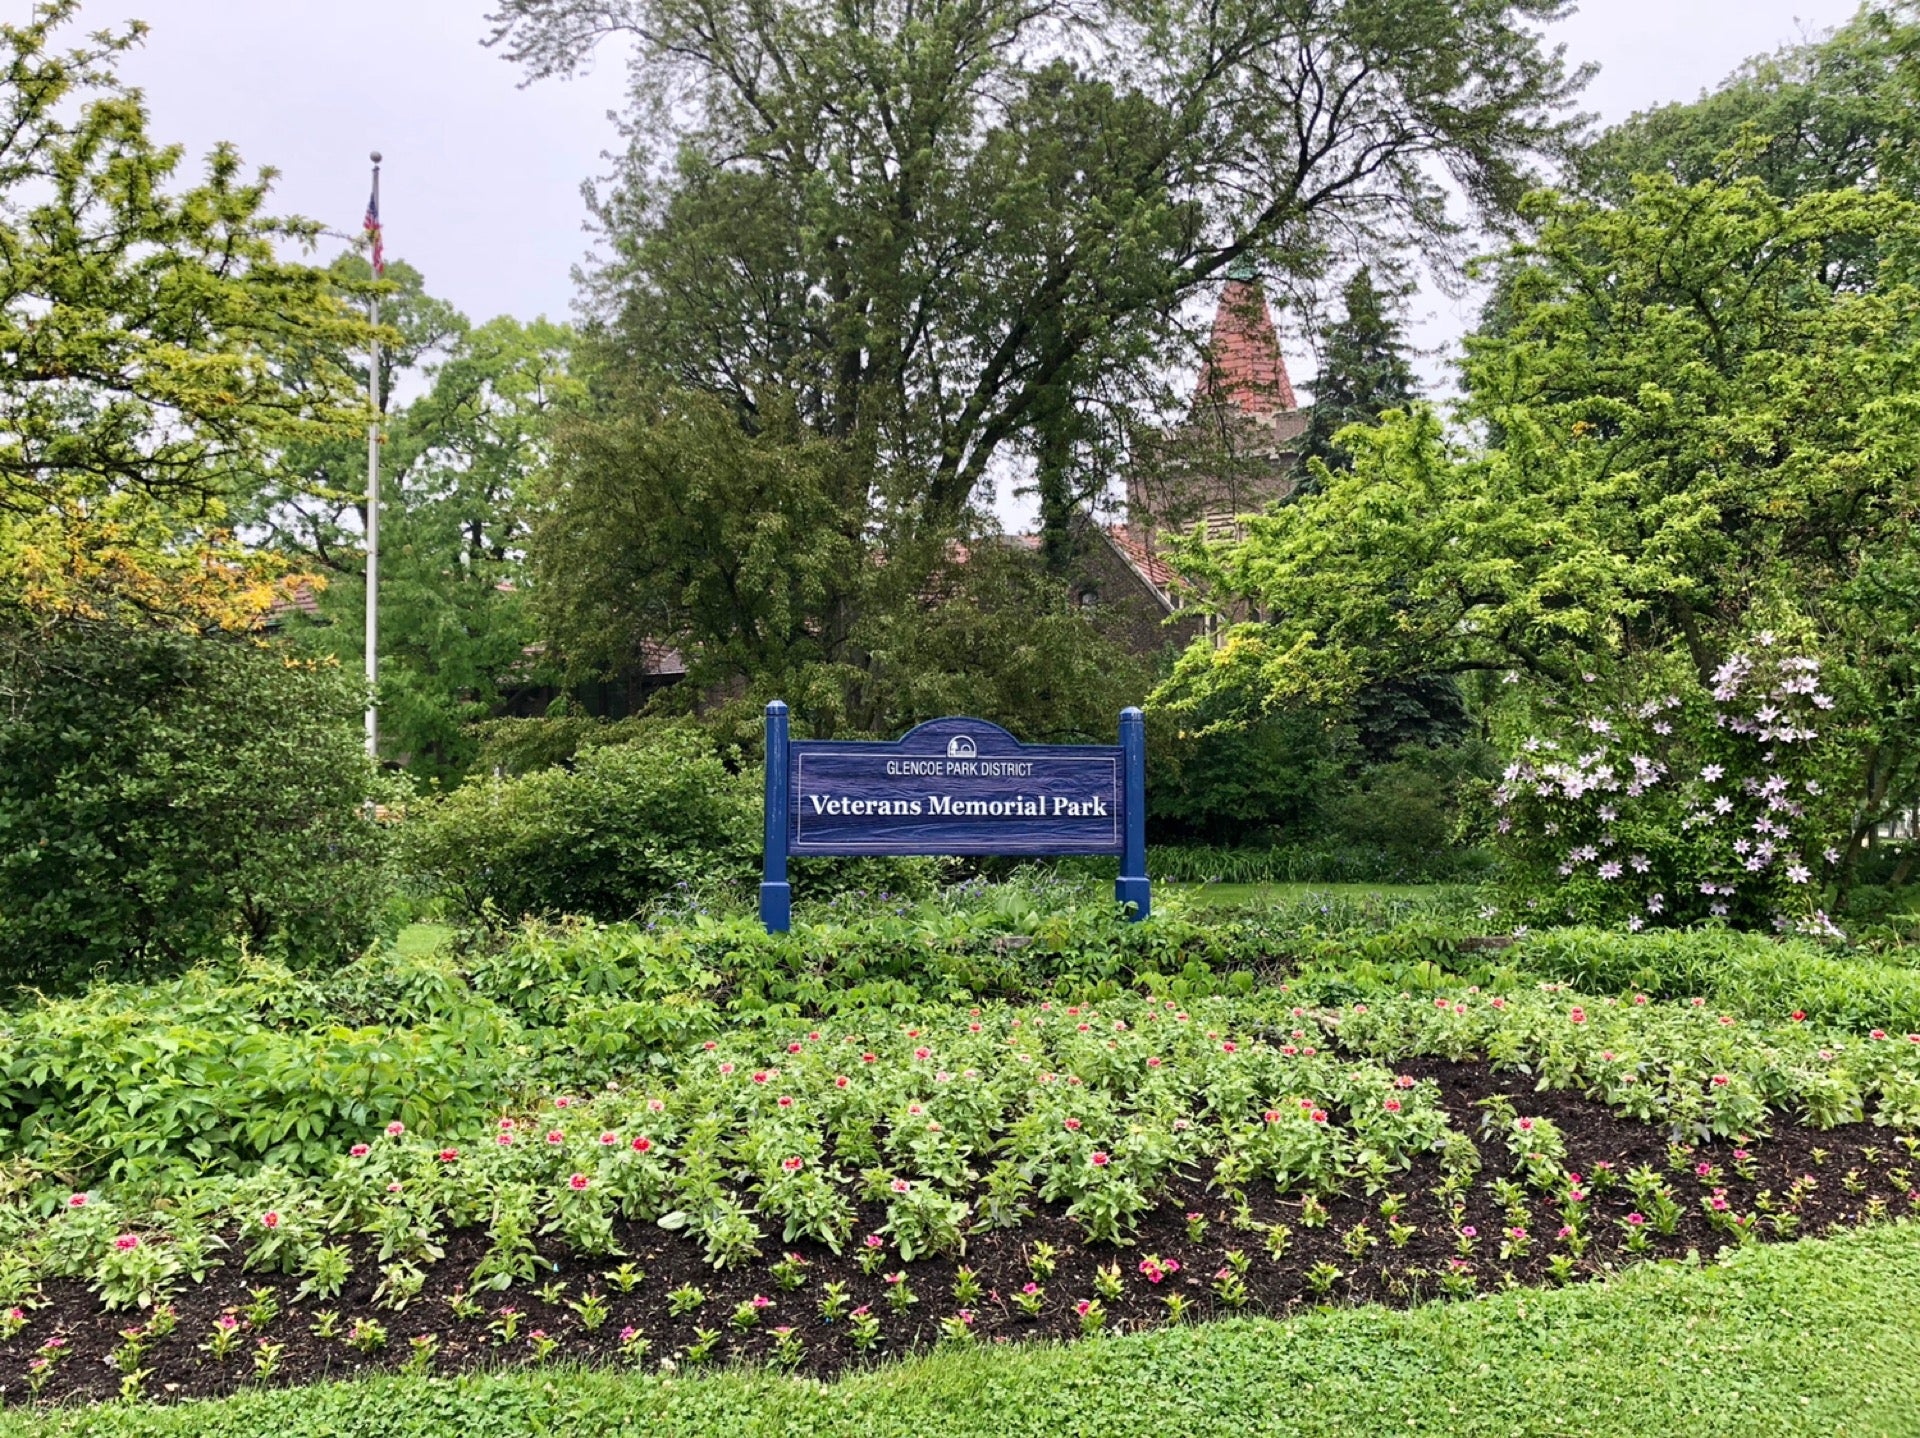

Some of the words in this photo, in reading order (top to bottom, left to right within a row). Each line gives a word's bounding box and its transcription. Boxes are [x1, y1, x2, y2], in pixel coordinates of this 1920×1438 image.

[886, 760, 943, 775] GLENCOE
[946, 761, 978, 776] PARK
[981, 761, 1033, 777] DISTRICT
[809, 795, 921, 816] Veterans
[928, 795, 1046, 816] Memorial
[1052, 796, 1108, 816] Park
